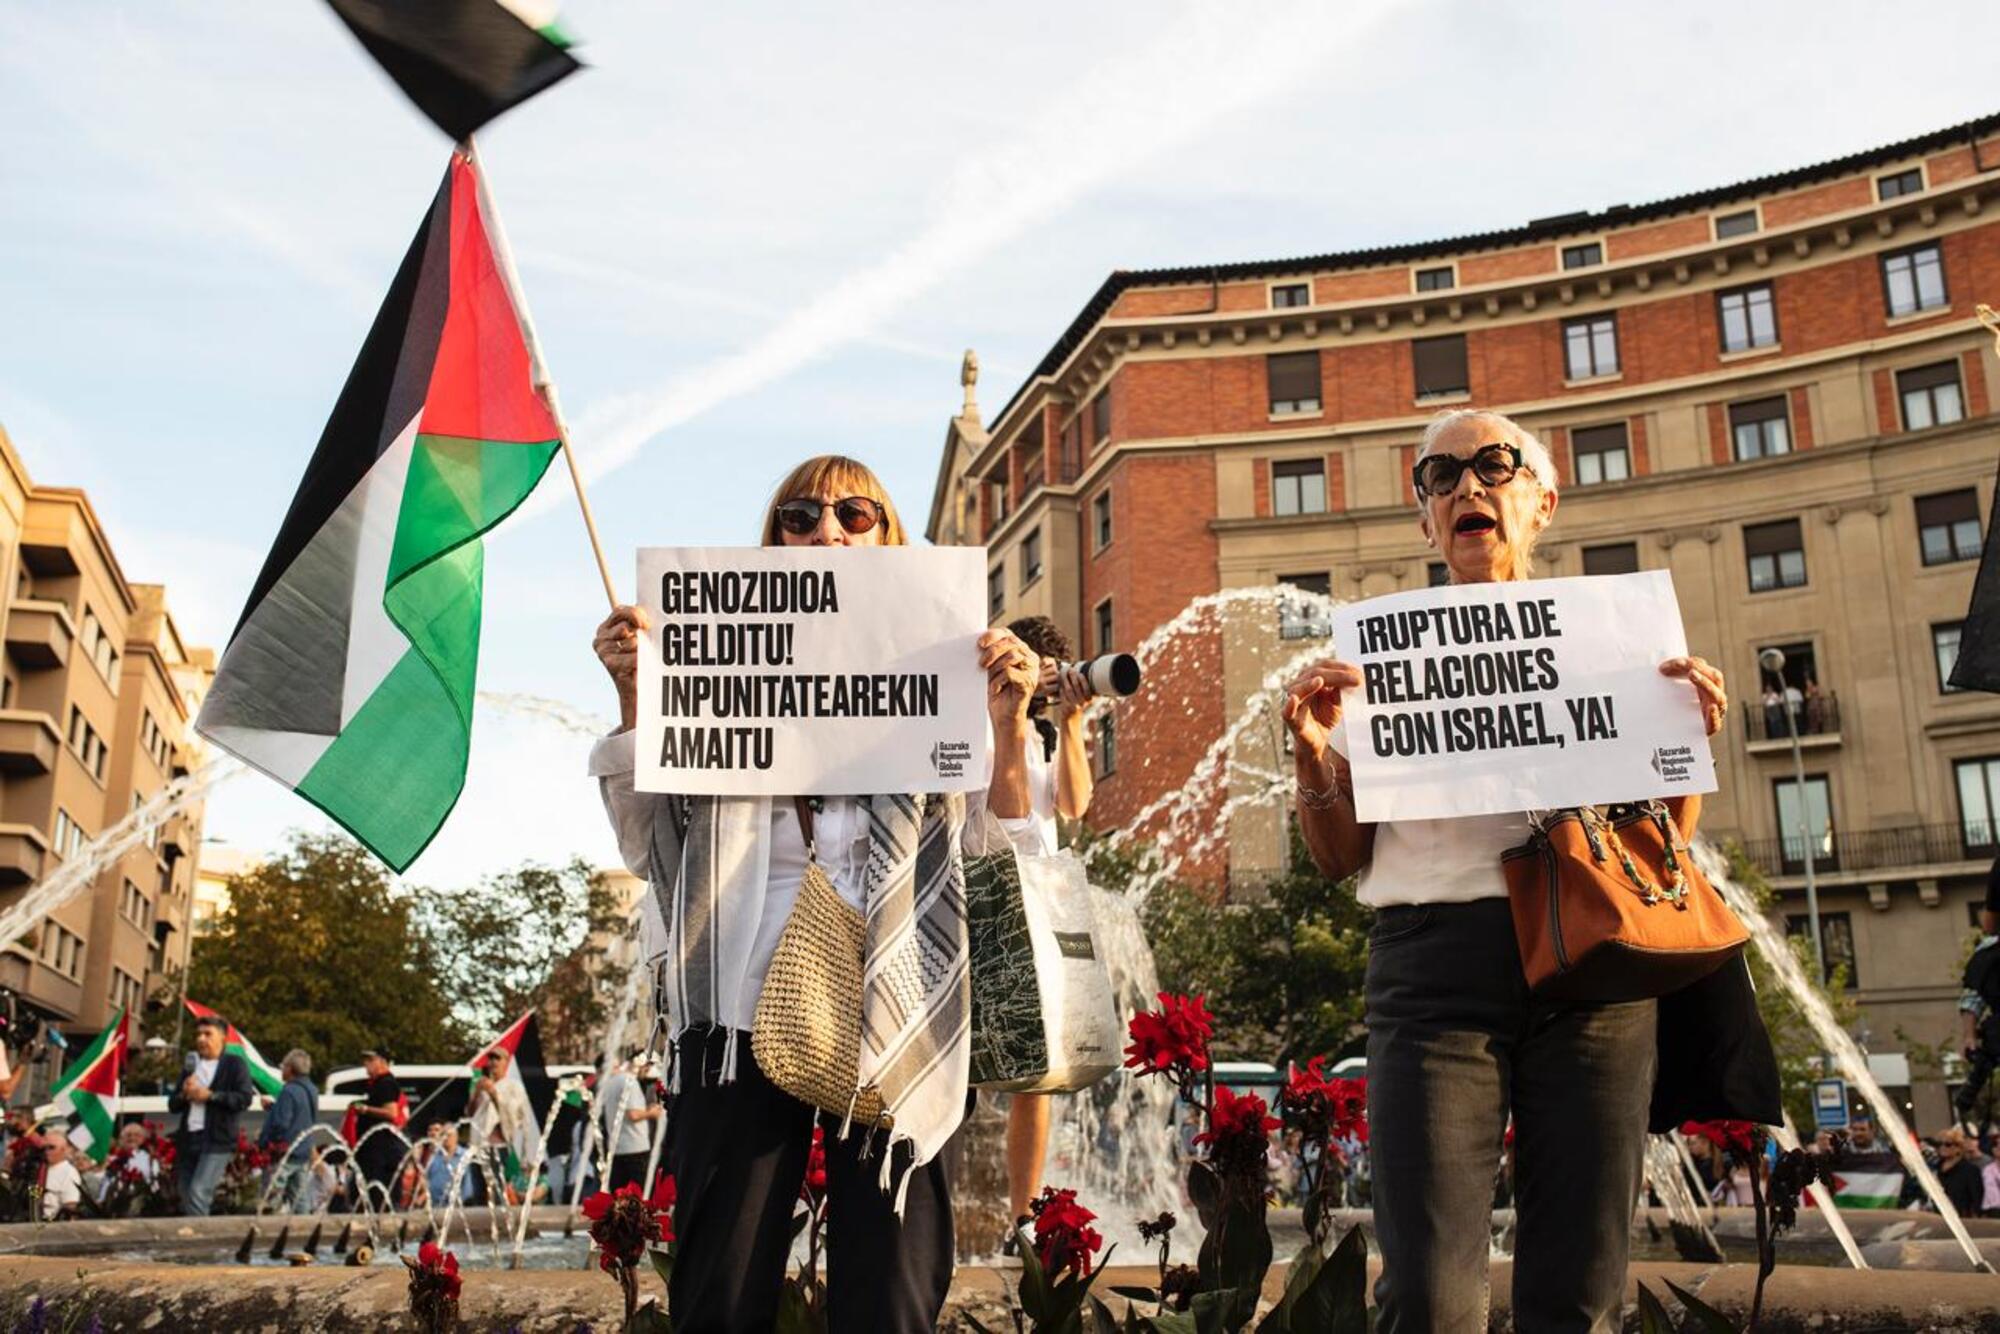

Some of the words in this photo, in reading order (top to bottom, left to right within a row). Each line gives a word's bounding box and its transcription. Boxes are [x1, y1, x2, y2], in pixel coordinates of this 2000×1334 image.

[662, 571, 839, 615] GENOZIDIOA
[662, 624, 794, 666] GELDITU!
[1356, 603, 1514, 655] ¡RUPTURA
[1516, 599, 1562, 639] DE
[662, 674, 938, 718] INPUNITATEAREKIN
[1363, 648, 1559, 705] RELACIONES
[660, 726, 773, 770] AMAITU
[1370, 711, 1439, 758] CON
[1441, 701, 1565, 753] ISRAEL,
[1565, 695, 1618, 742] YA!
